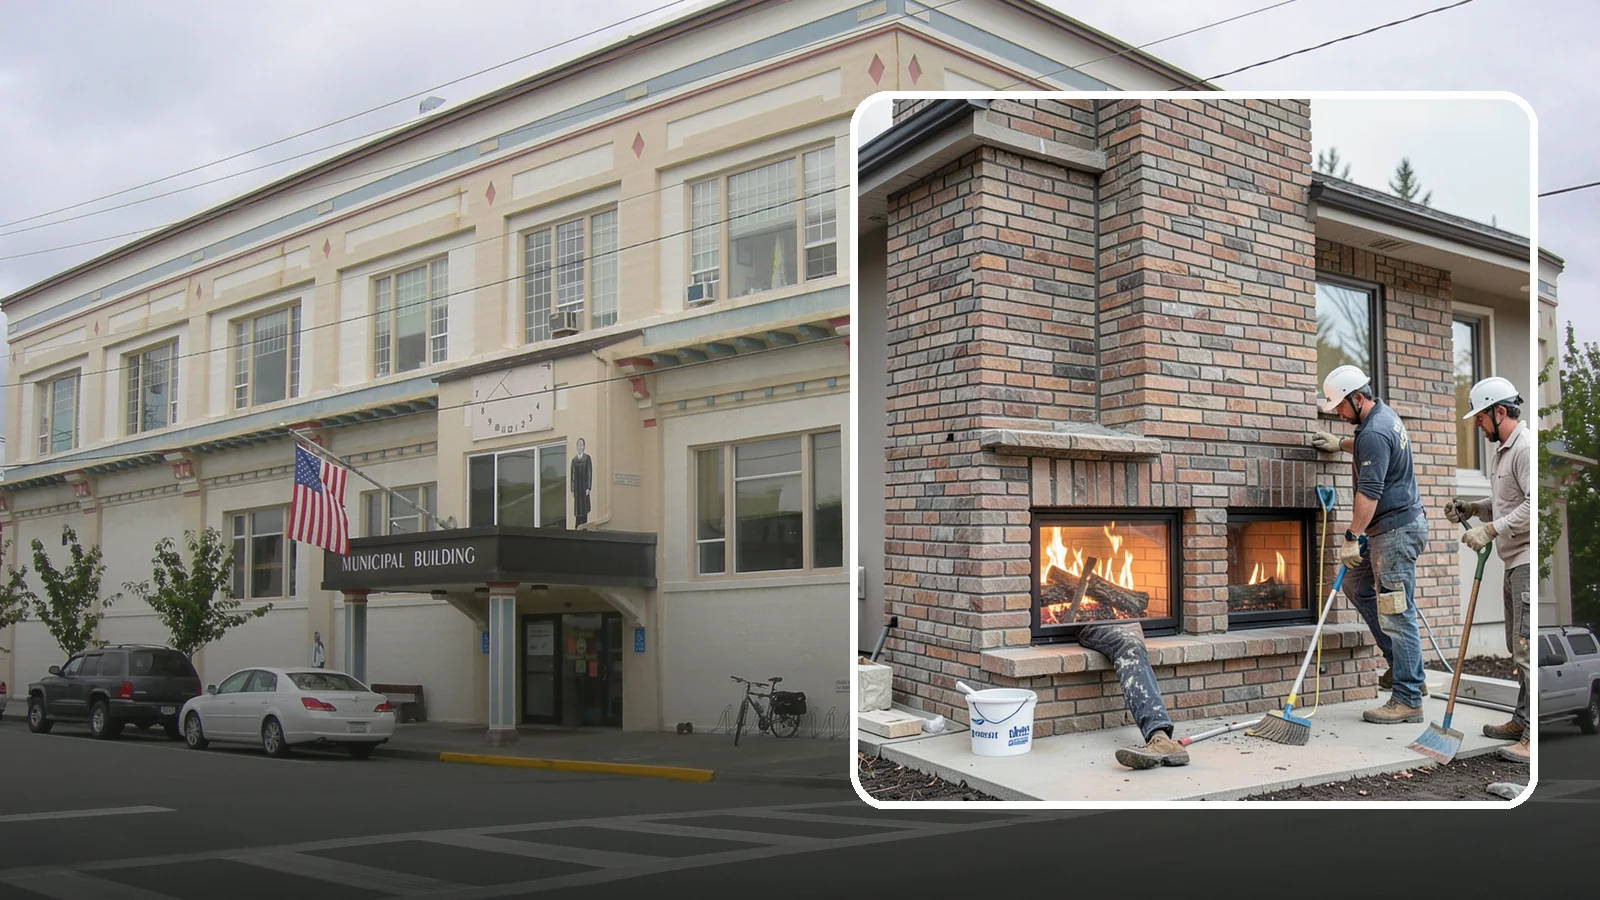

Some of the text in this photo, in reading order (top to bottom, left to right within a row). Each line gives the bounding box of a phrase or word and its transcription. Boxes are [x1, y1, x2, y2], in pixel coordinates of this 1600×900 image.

[475, 390, 479, 398] 7
[536, 402, 540, 410] 4
[480, 407, 485, 415] 8
[488, 418, 492, 426] 9
[529, 414, 533, 422] 3
[521, 420, 525, 428] 2
[342, 546, 475, 572] MUNICIPAL BUILDING
